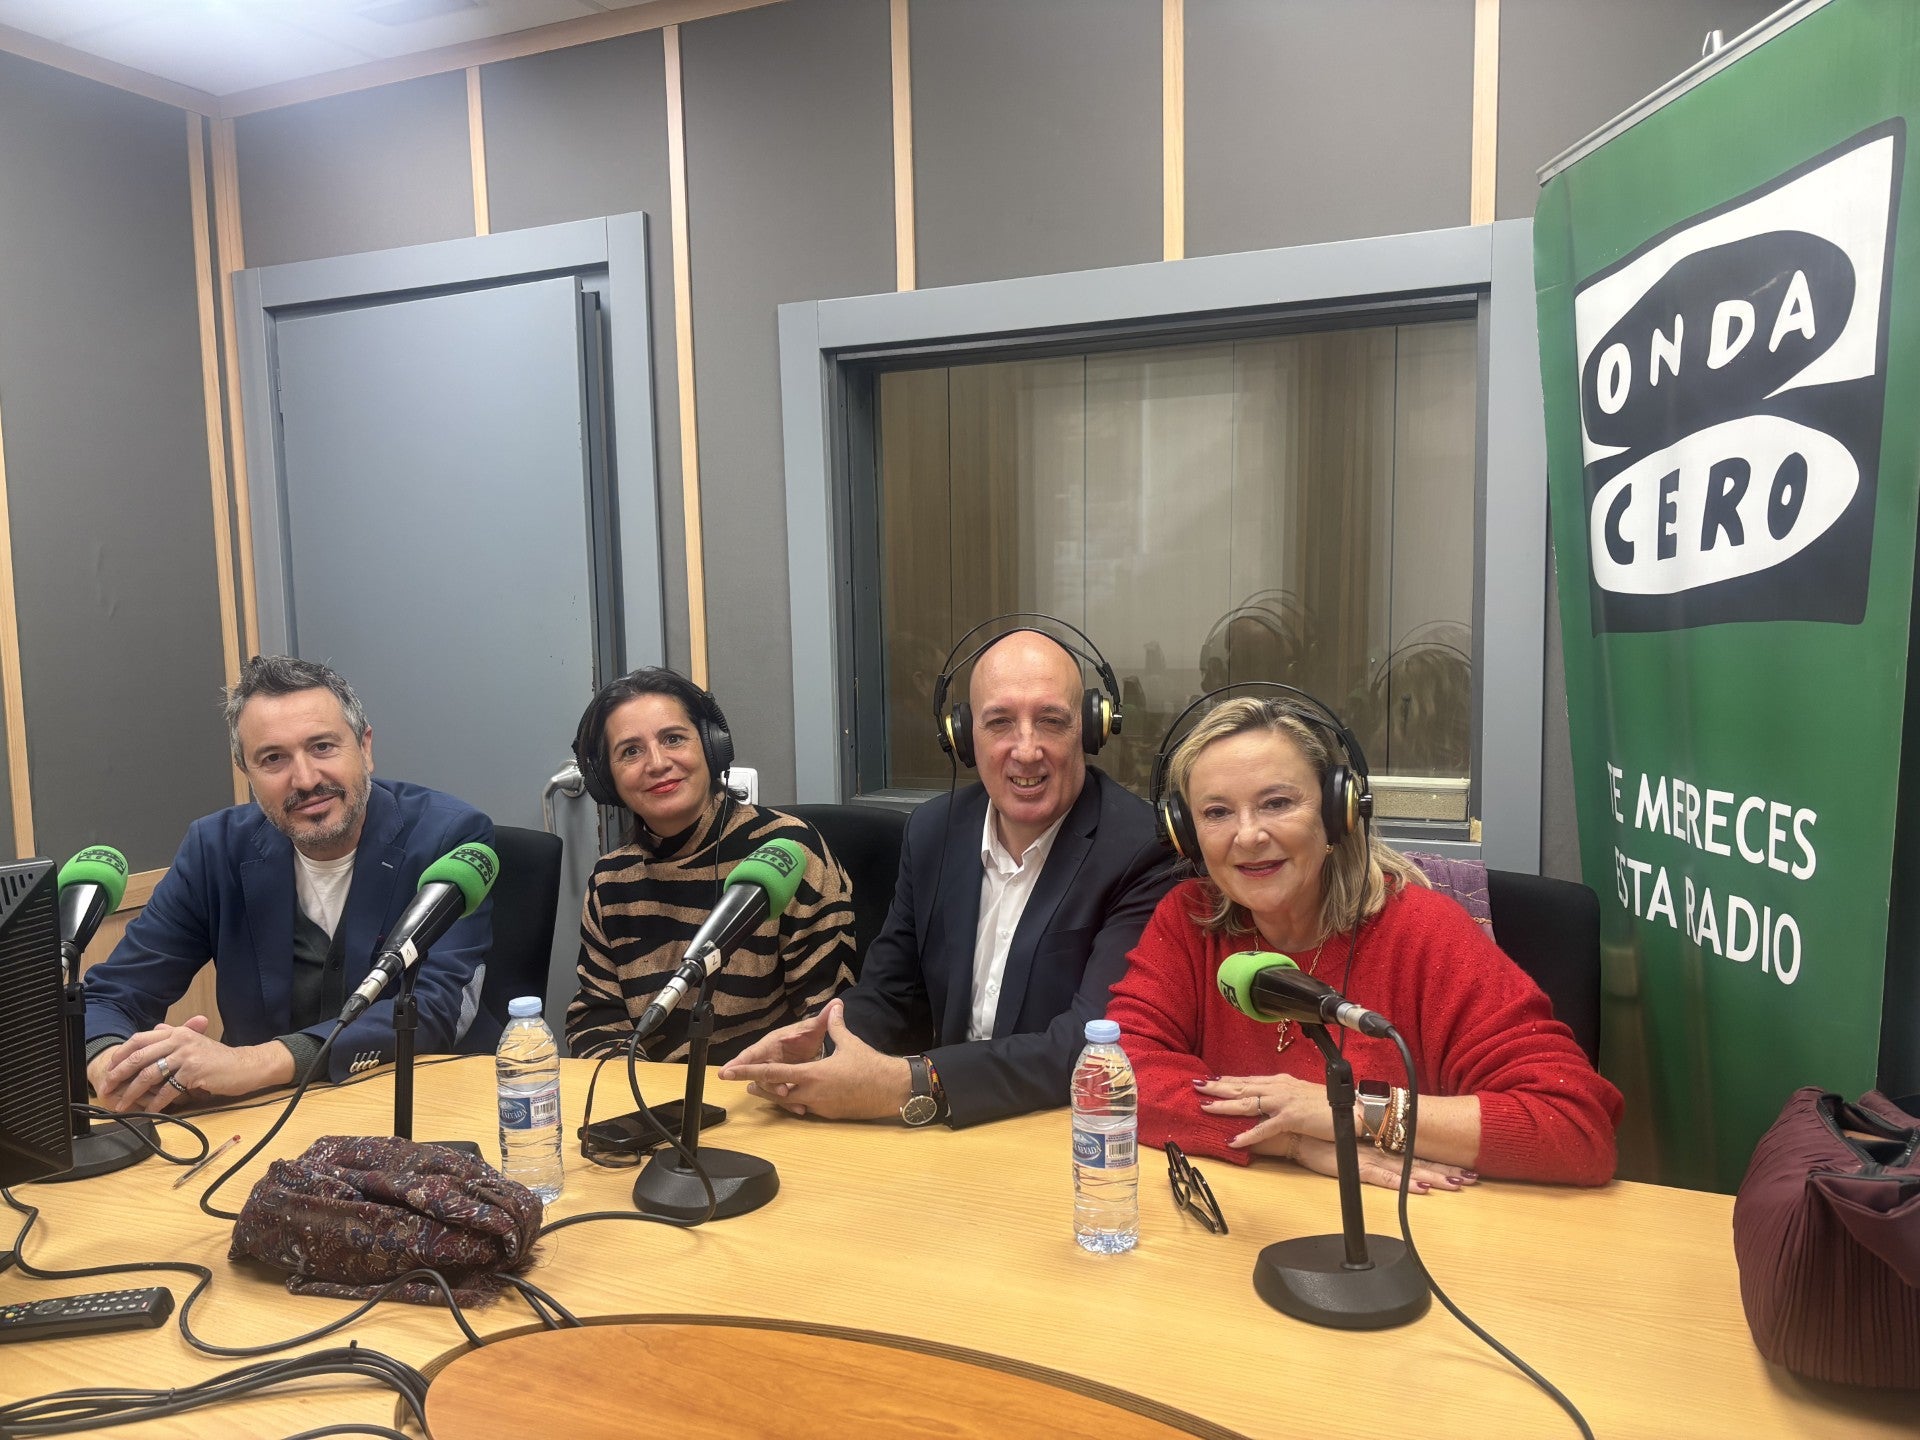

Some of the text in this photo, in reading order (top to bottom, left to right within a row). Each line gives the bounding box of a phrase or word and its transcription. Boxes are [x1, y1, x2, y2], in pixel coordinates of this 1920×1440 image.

[1597, 270, 1816, 414] ONDA
[1604, 452, 1808, 566] CERO
[1635, 773, 1817, 880] MERECES
[1615, 846, 1801, 985] ESTA RADIO
